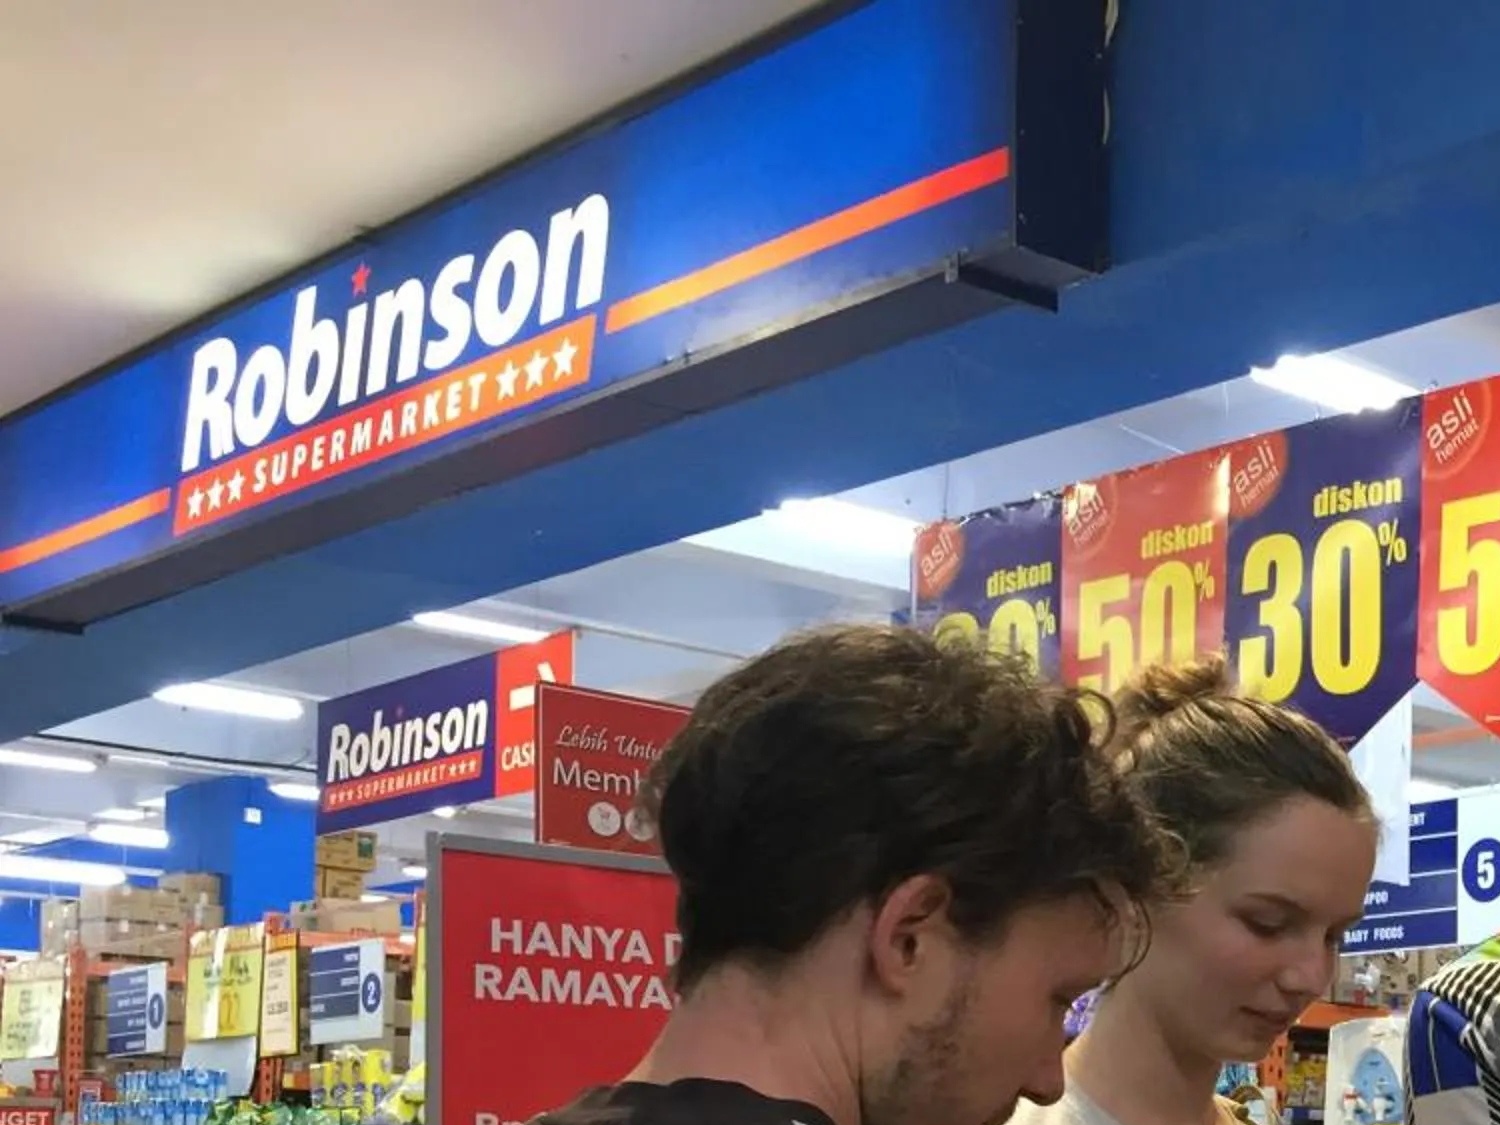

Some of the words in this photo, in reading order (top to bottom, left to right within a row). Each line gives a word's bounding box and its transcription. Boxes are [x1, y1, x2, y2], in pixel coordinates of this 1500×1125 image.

[180, 191, 610, 474] Robinson
[251, 370, 488, 495] SUPERMARKET
[1426, 389, 1473, 449] asli
[1435, 418, 1480, 465] hemat
[1234, 440, 1275, 494] asli
[1240, 466, 1280, 509] hemat
[1069, 493, 1105, 536] asli
[1313, 476, 1402, 519] diskon
[920, 525, 954, 577] asli
[1141, 519, 1215, 560] diskon
[986, 561, 1053, 599] diskon
[327, 699, 489, 784] Robinson
[356, 764, 446, 801] SUPERMARKET
[1477, 851, 1496, 890] 5
[491, 917, 653, 965] HANYA
[1344, 930, 1369, 944] BABY
[1374, 926, 1405, 941] FOODS
[367, 981, 376, 1005] 2
[475, 963, 680, 1011] RAMAYA
